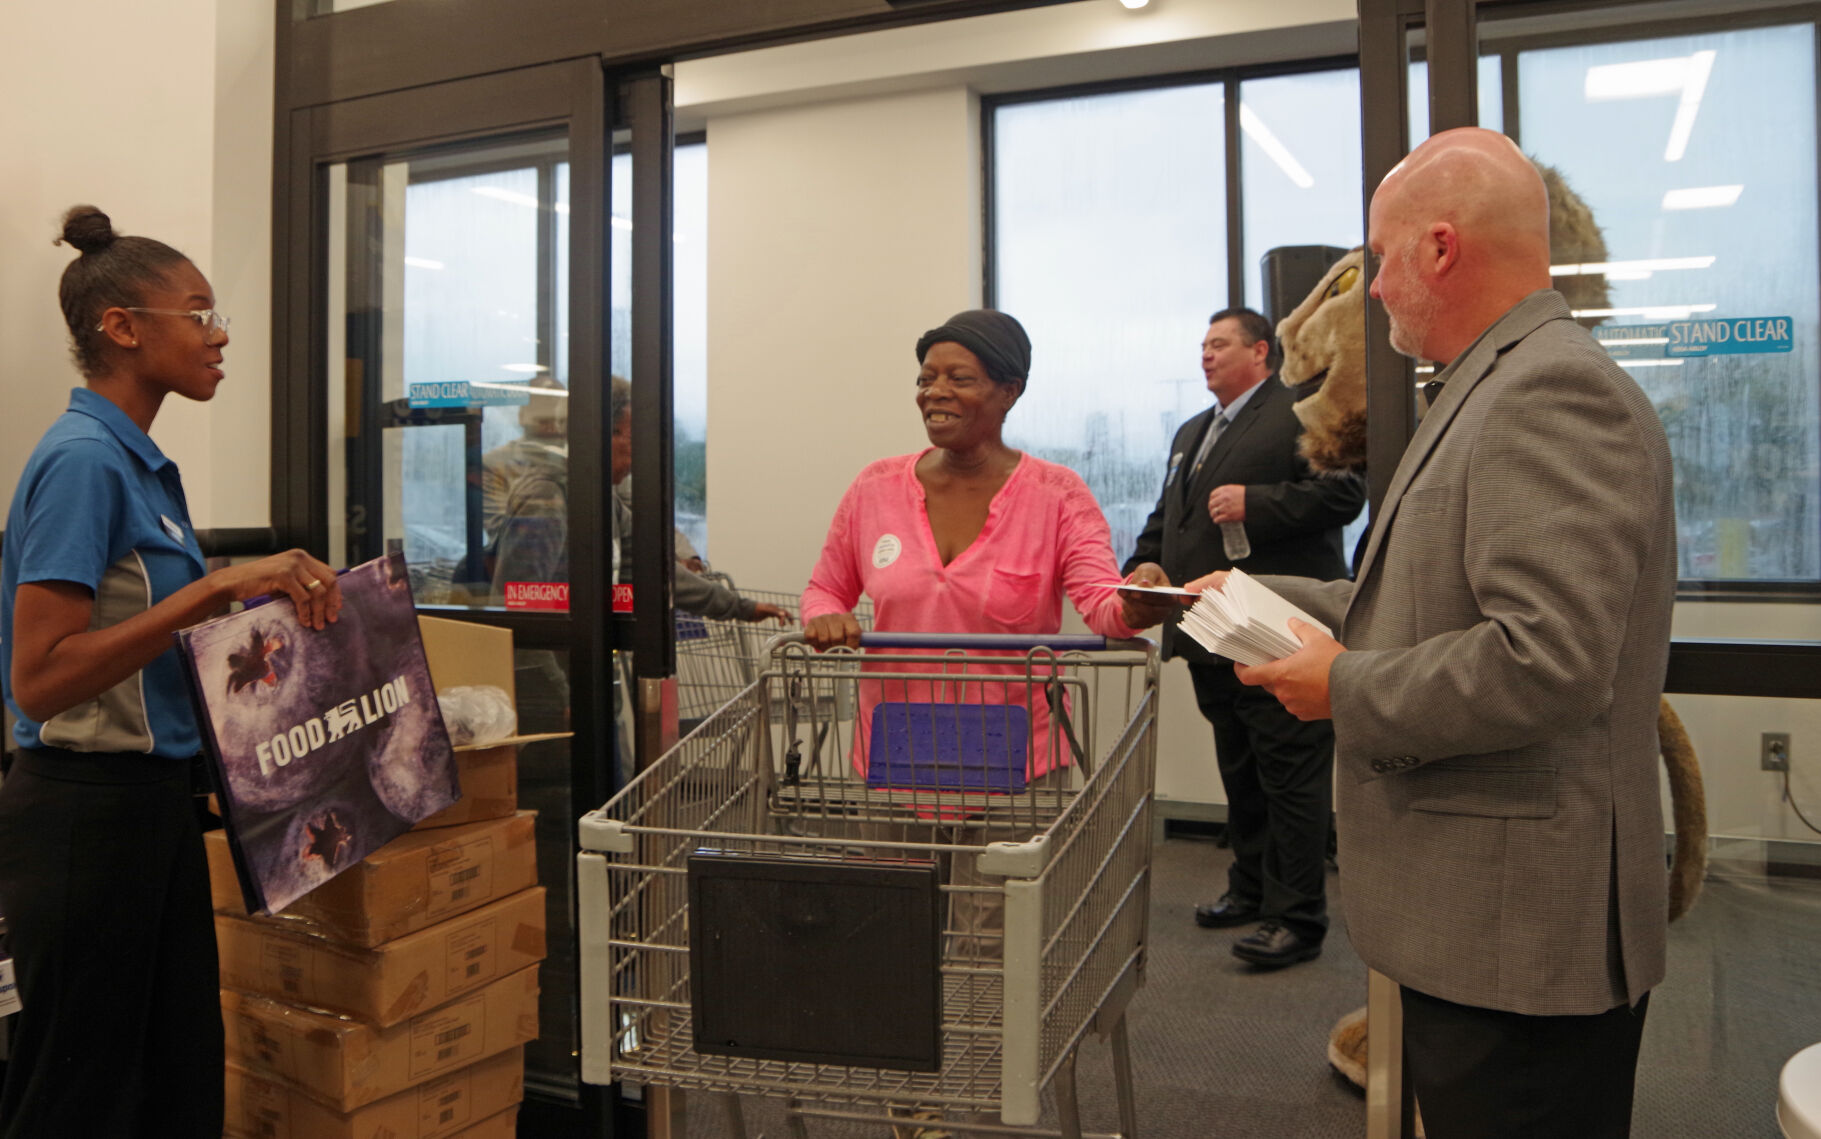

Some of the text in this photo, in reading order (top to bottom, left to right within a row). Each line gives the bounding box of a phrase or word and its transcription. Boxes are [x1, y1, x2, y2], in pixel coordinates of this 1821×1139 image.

[1672, 319, 1789, 344] STAND CLEAR
[411, 383, 469, 400] STAND CLEAR
[507, 585, 569, 601] IN EMERGENCY
[255, 675, 411, 776] FOOD LION
